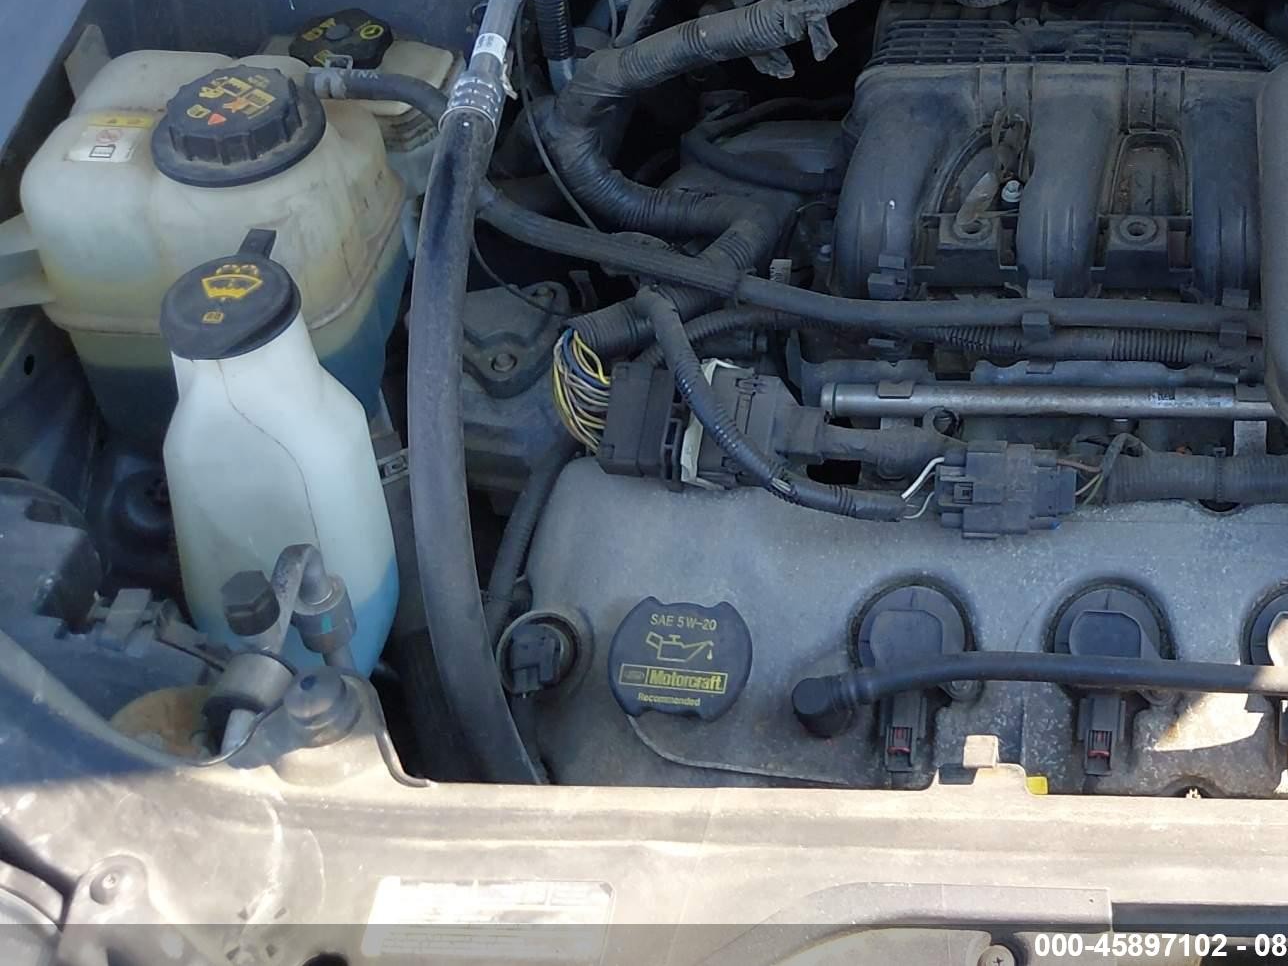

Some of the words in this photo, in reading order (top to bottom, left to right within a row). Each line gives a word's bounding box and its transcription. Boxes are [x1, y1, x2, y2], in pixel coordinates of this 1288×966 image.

[649, 613, 674, 628] SAE
[648, 668, 724, 691] Motorcraft
[638, 691, 701, 707] Recommended
